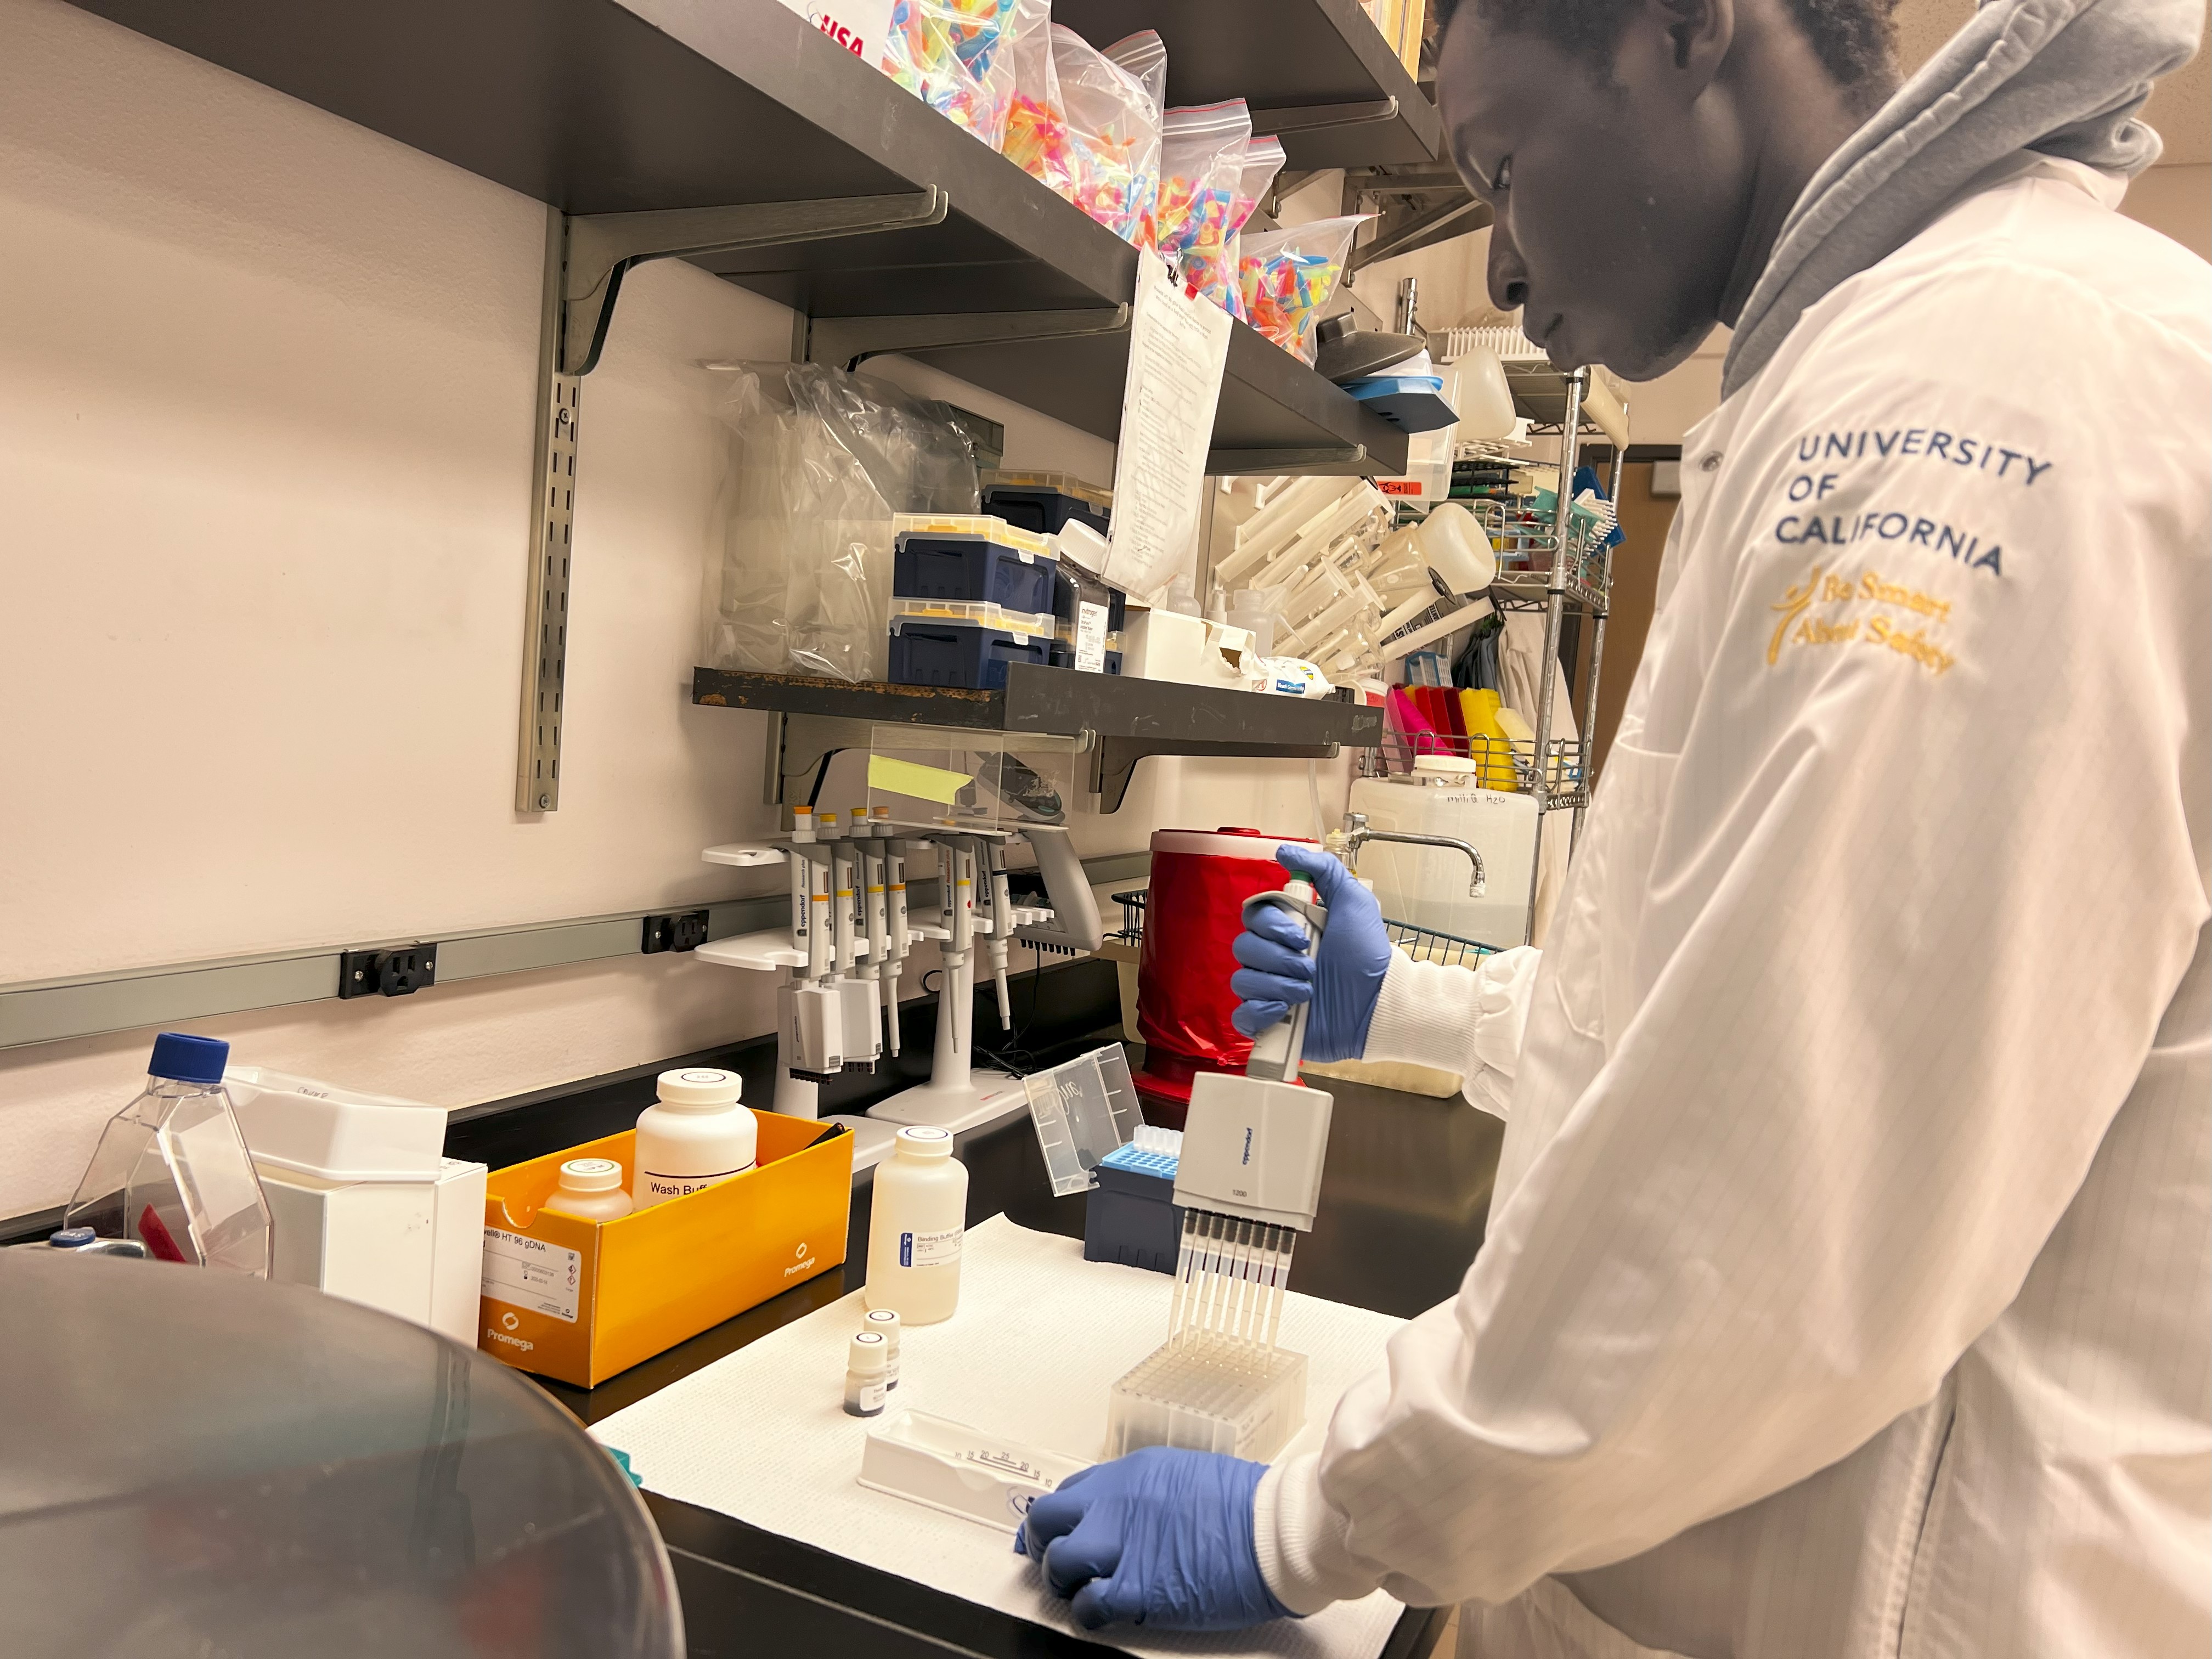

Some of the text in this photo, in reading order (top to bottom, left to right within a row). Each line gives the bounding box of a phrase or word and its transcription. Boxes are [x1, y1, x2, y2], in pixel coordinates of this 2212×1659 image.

[821, 14, 864, 58] USA
[1799, 429, 2052, 486] UNIVERSITY
[1789, 474, 1838, 501] OF
[1775, 513, 2002, 577] CALIFORNIA
[1242, 1127, 1253, 1165] eppendorf
[651, 1182, 679, 1195] Wash
[502, 1233, 512, 1242] HT
[514, 1236, 523, 1245] 96
[525, 1241, 546, 1252] gDNA
[784, 1257, 815, 1277] Promega
[487, 1328, 533, 1352] Promega
[968, 1451, 974, 1459] 15
[981, 1450, 990, 1458] 20
[1001, 1452, 1009, 1460] 25
[1020, 1462, 1029, 1470] 20
[1034, 1470, 1041, 1478] 15
[1045, 1479, 1052, 1487] 10
